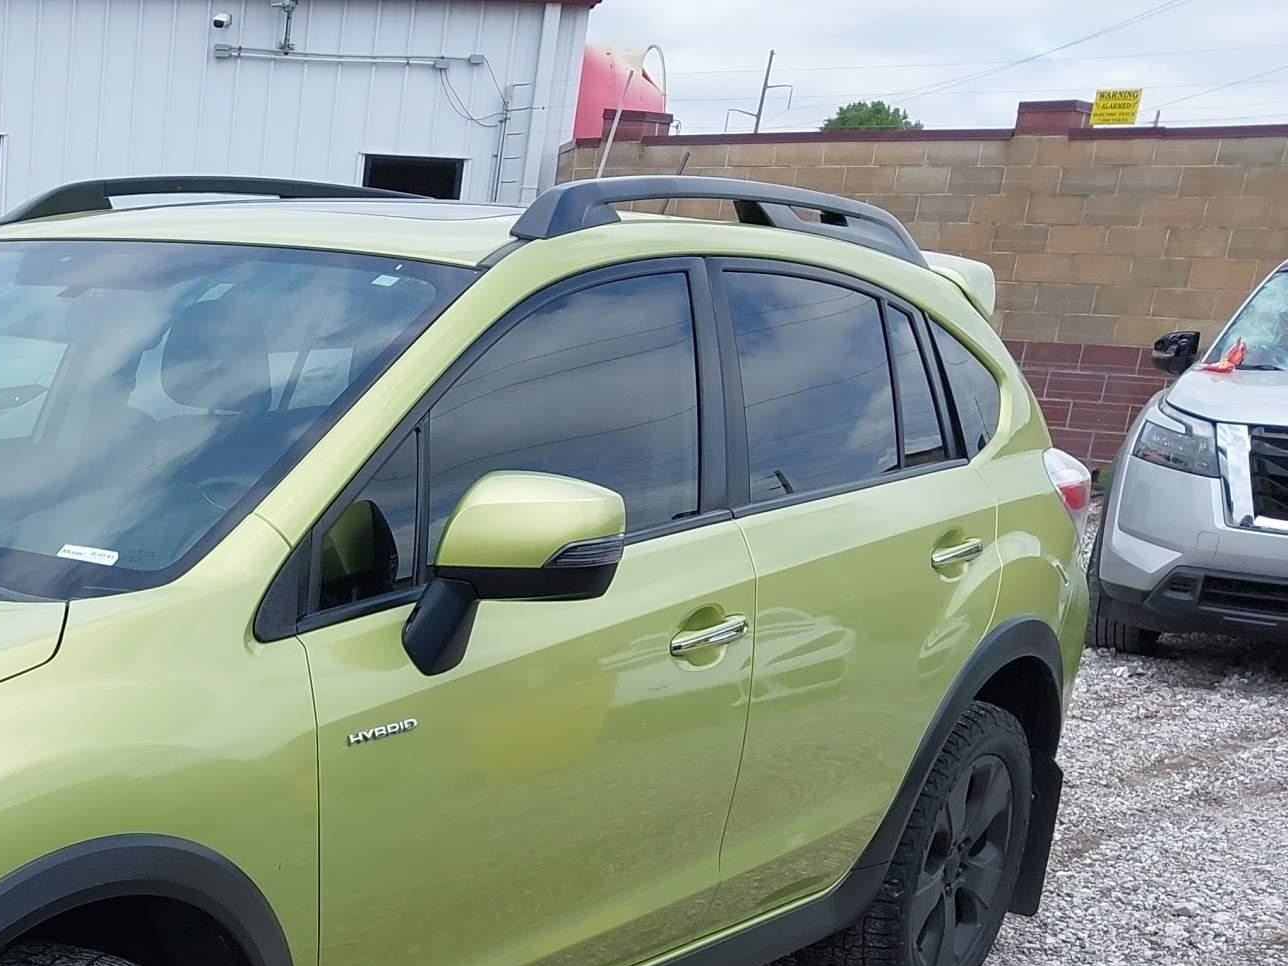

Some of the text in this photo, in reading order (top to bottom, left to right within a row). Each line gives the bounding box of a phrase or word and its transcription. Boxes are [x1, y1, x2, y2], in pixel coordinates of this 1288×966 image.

[1098, 90, 1139, 100] WARNING
[1101, 102, 1132, 110] ALARMED
[347, 718, 418, 745] HYBRID
